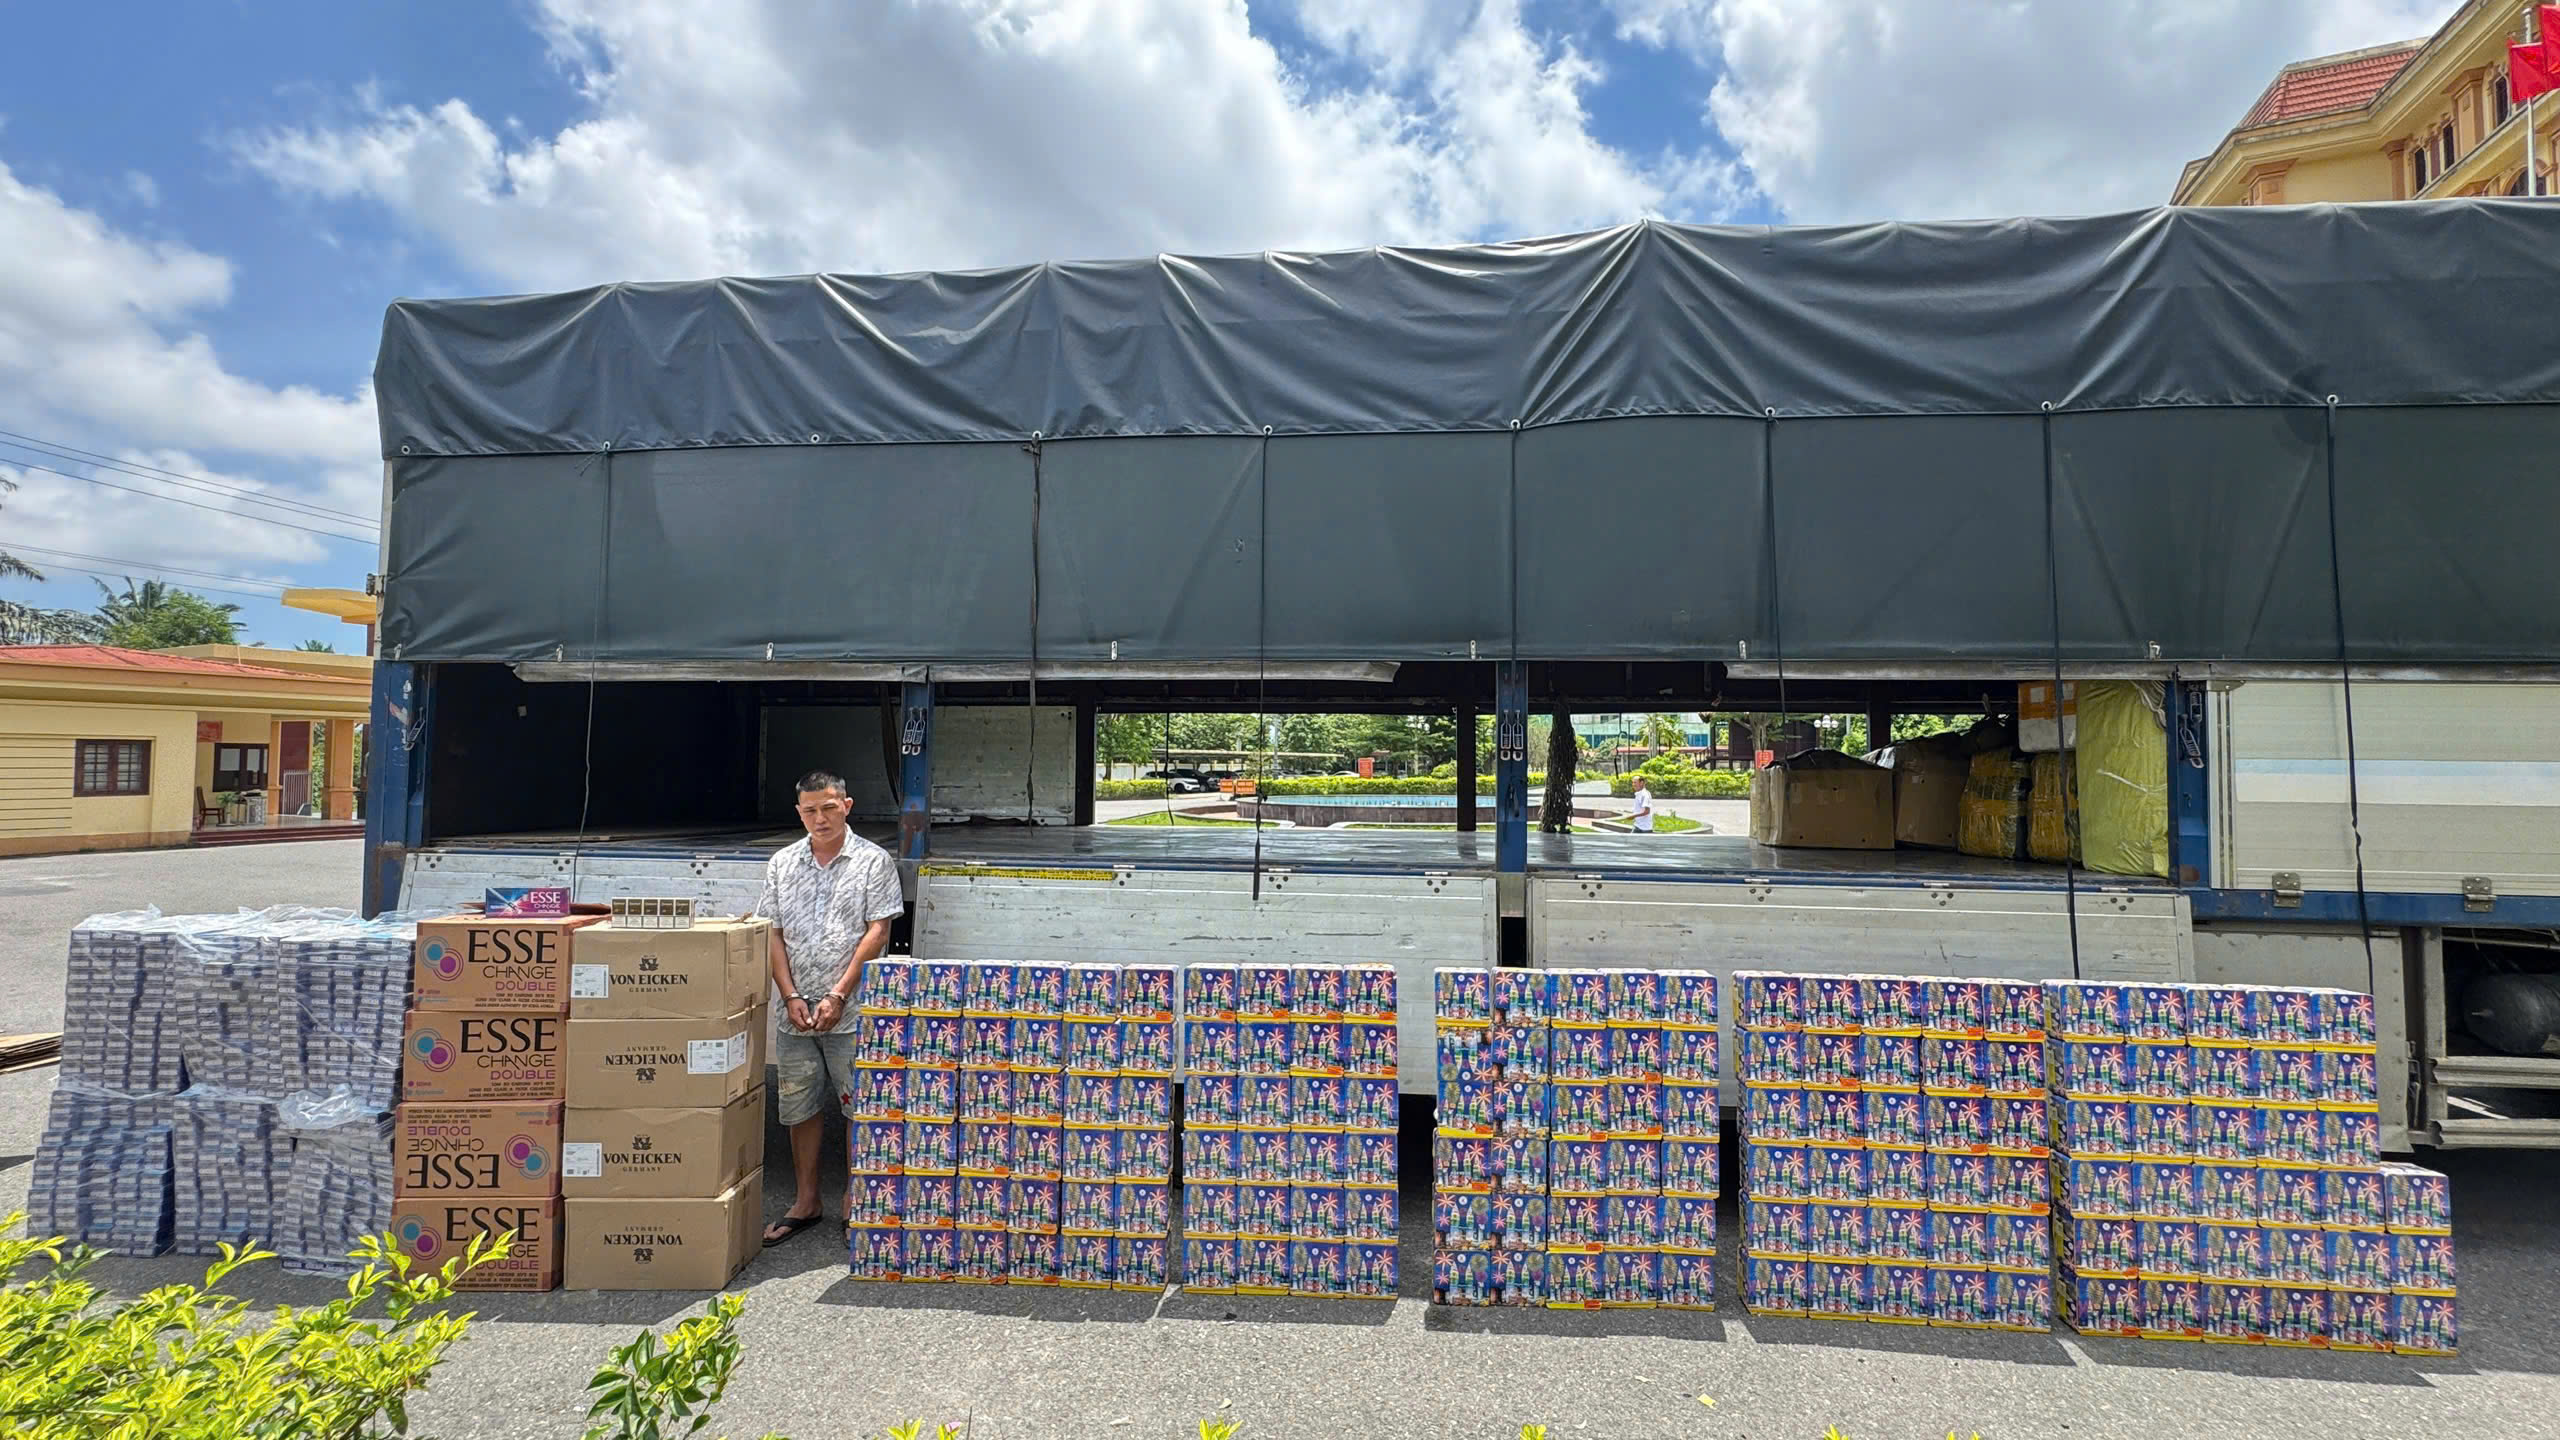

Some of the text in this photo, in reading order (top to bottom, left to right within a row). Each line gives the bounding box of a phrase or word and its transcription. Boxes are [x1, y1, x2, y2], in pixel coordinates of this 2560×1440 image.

[530, 891, 561, 904] ESSE
[467, 929, 558, 964] ESSE
[483, 965, 555, 983] CHANGE
[610, 973, 688, 986] VON EICKEN
[495, 981, 556, 992] DOUBLE
[460, 1018, 558, 1053] ESSE
[477, 1053, 555, 1072] CHANGE
[605, 1053, 686, 1066] VON EICKEN
[490, 1069, 556, 1080] DOUBLE
[407, 1126, 471, 1136] DOUBLE
[407, 1135, 484, 1151] CHANGE
[603, 1152, 682, 1164] VON EICKEN
[405, 1154, 501, 1189] ESSE
[445, 1207, 541, 1242] ESSE
[603, 1234, 683, 1246] VON EICKEN
[475, 1260, 539, 1270] DOUBLE
